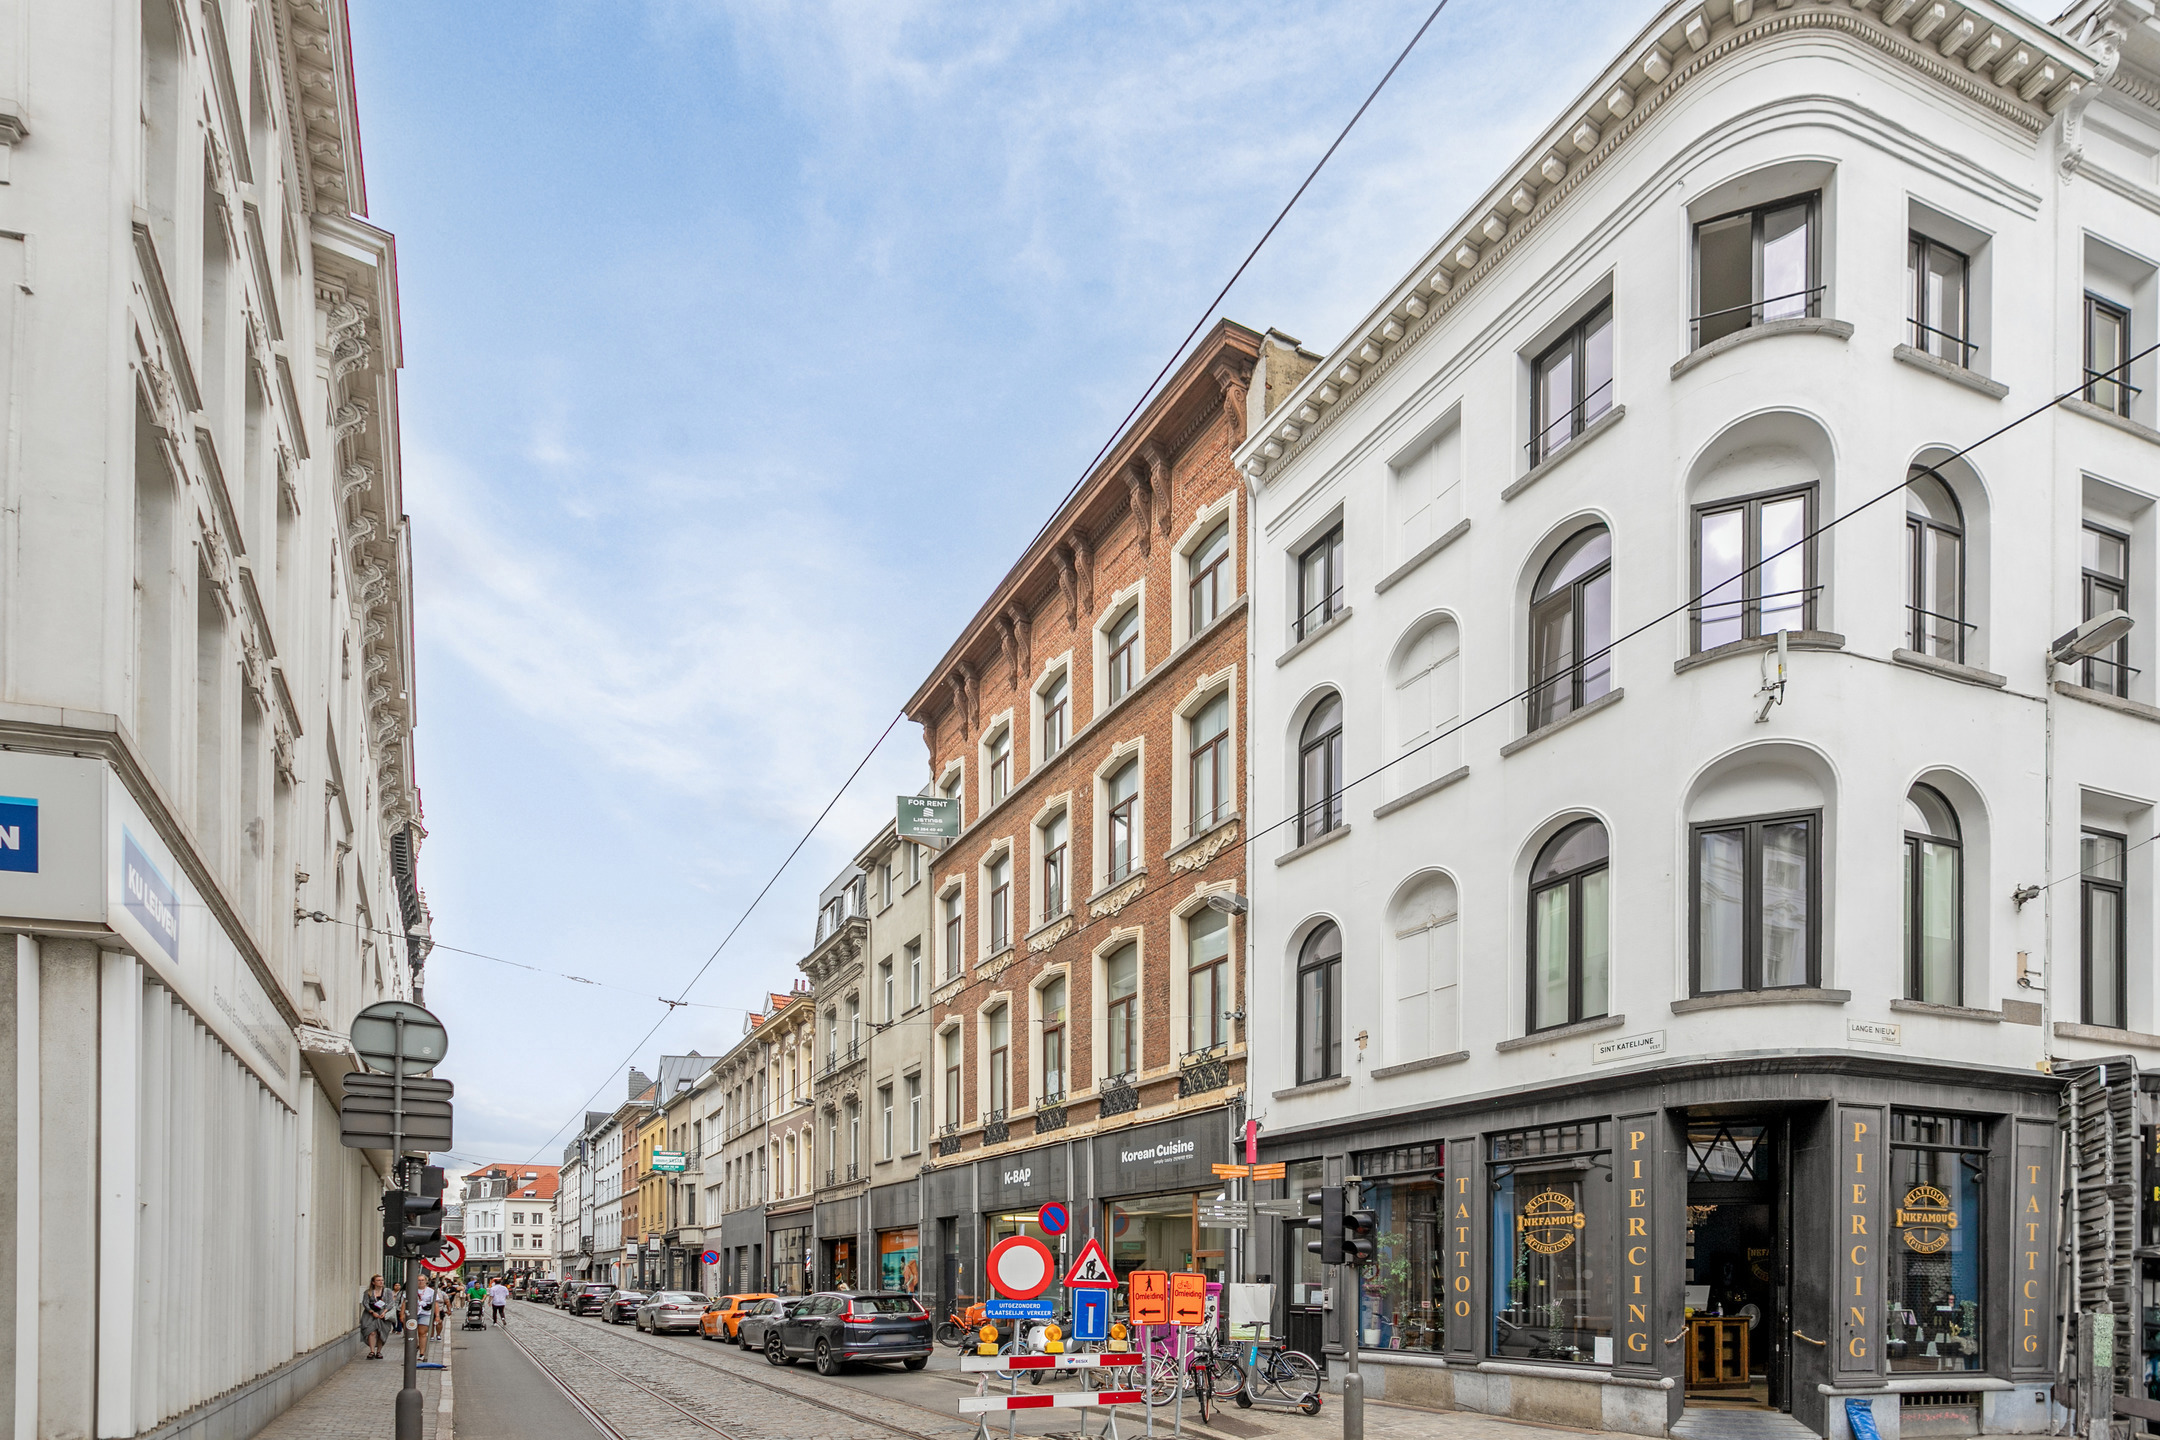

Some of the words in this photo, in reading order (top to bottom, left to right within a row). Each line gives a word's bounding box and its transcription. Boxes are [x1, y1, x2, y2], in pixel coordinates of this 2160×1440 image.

[927, 800, 948, 808] RENT
[128, 863, 143, 901] KU
[144, 883, 177, 942] LEUVEN
[1851, 1024, 1873, 1033] LANGE
[1875, 1027, 1896, 1035] NIEUW
[1600, 1044, 1615, 1054] SINT
[1616, 1037, 1654, 1051] KATELIJNE
[1121, 1148, 1155, 1163] Korean
[1156, 1139, 1195, 1157] Cuisine
[1004, 1167, 1031, 1185] K-BAP
[1530, 1193, 1569, 1207] TATTOO
[1910, 1188, 1944, 1202] TATTOO
[1516, 1212, 1586, 1232] INKFAMOUS
[1896, 1208, 1958, 1229] INKFAMOUS
[1455, 1177, 1470, 1317] TATTOO
[1531, 1239, 1569, 1252] PIERCING
[1627, 1131, 1648, 1352] PIERCING
[1849, 1122, 1868, 1358] PIERCING
[1910, 1239, 1944, 1252] PIERCING
[1135, 1292, 1164, 1301] Omleiding
[1174, 1290, 1202, 1300] Omleiding
